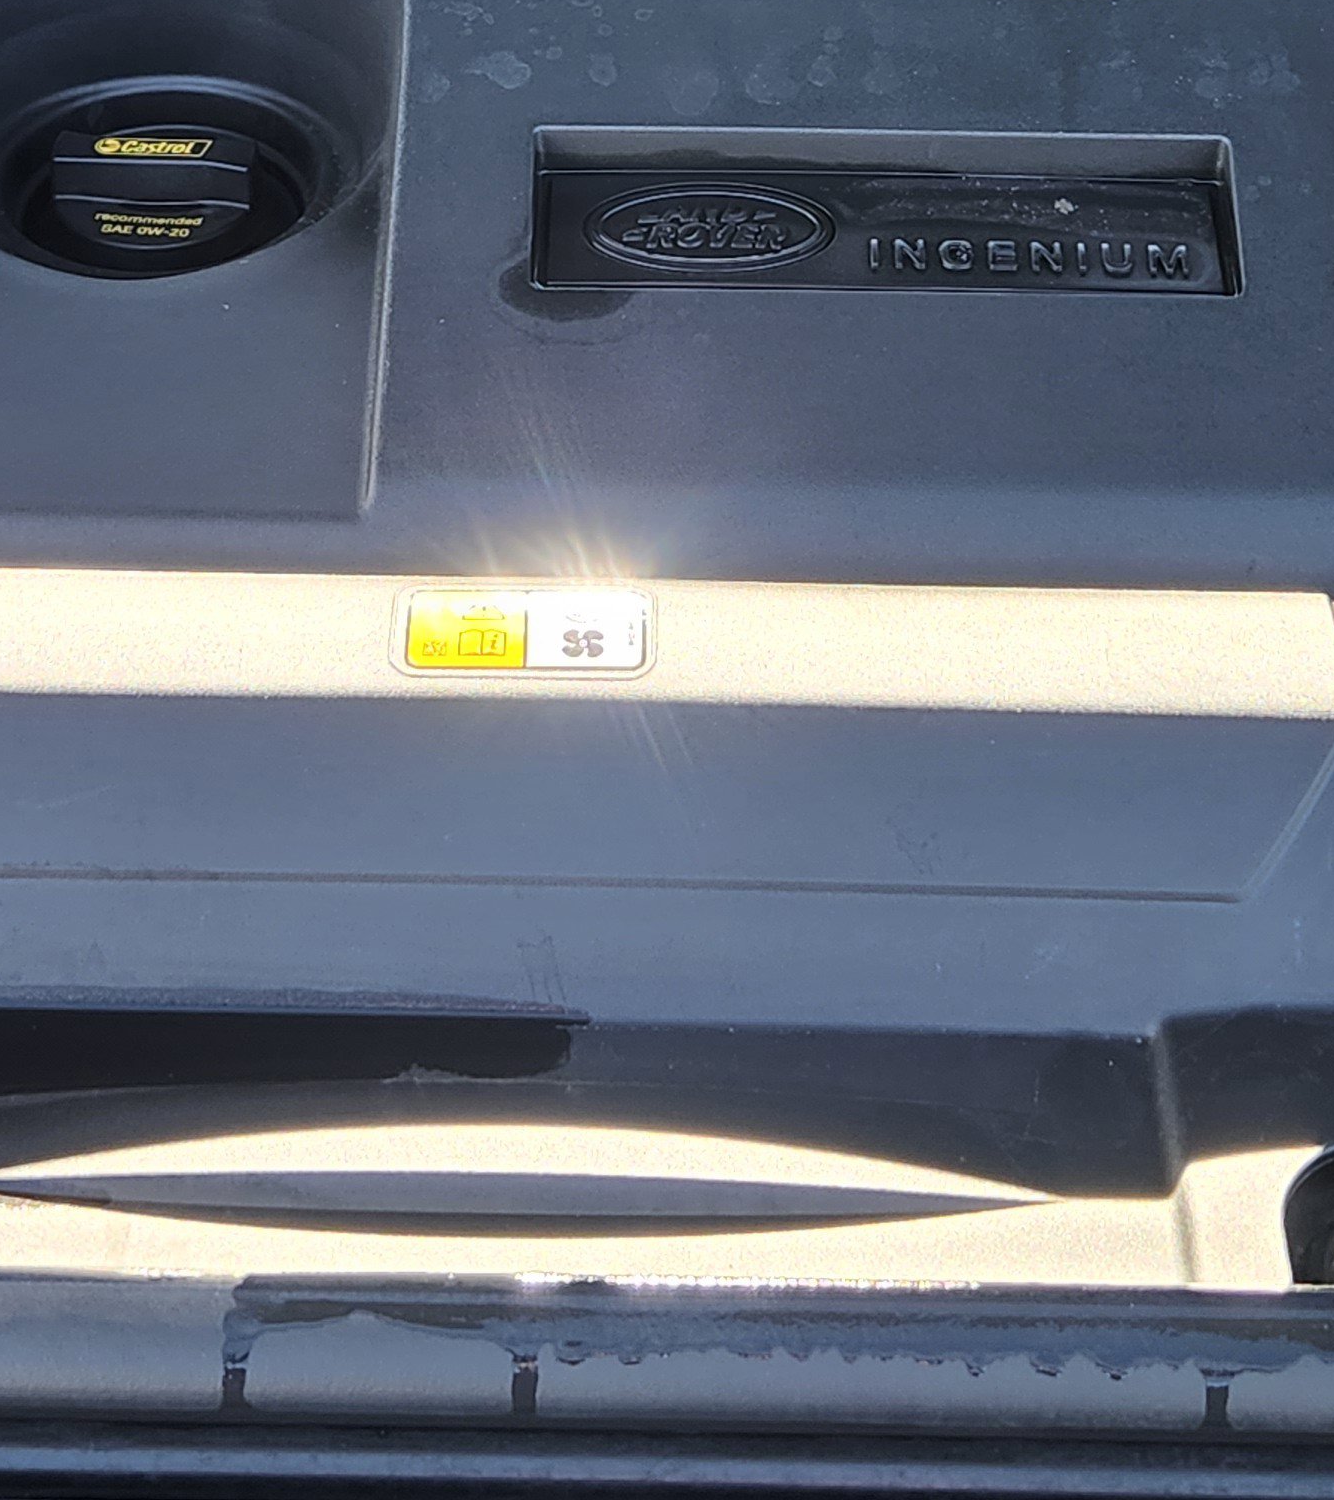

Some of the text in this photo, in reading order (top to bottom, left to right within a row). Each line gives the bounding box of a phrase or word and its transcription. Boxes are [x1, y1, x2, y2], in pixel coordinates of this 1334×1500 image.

[120, 140, 195, 155] Castrol
[94, 213, 204, 226] recommended
[101, 224, 190, 238] SAE 0W-20
[645, 222, 786, 250] ROVER
[869, 237, 1190, 278] INGENIUM
